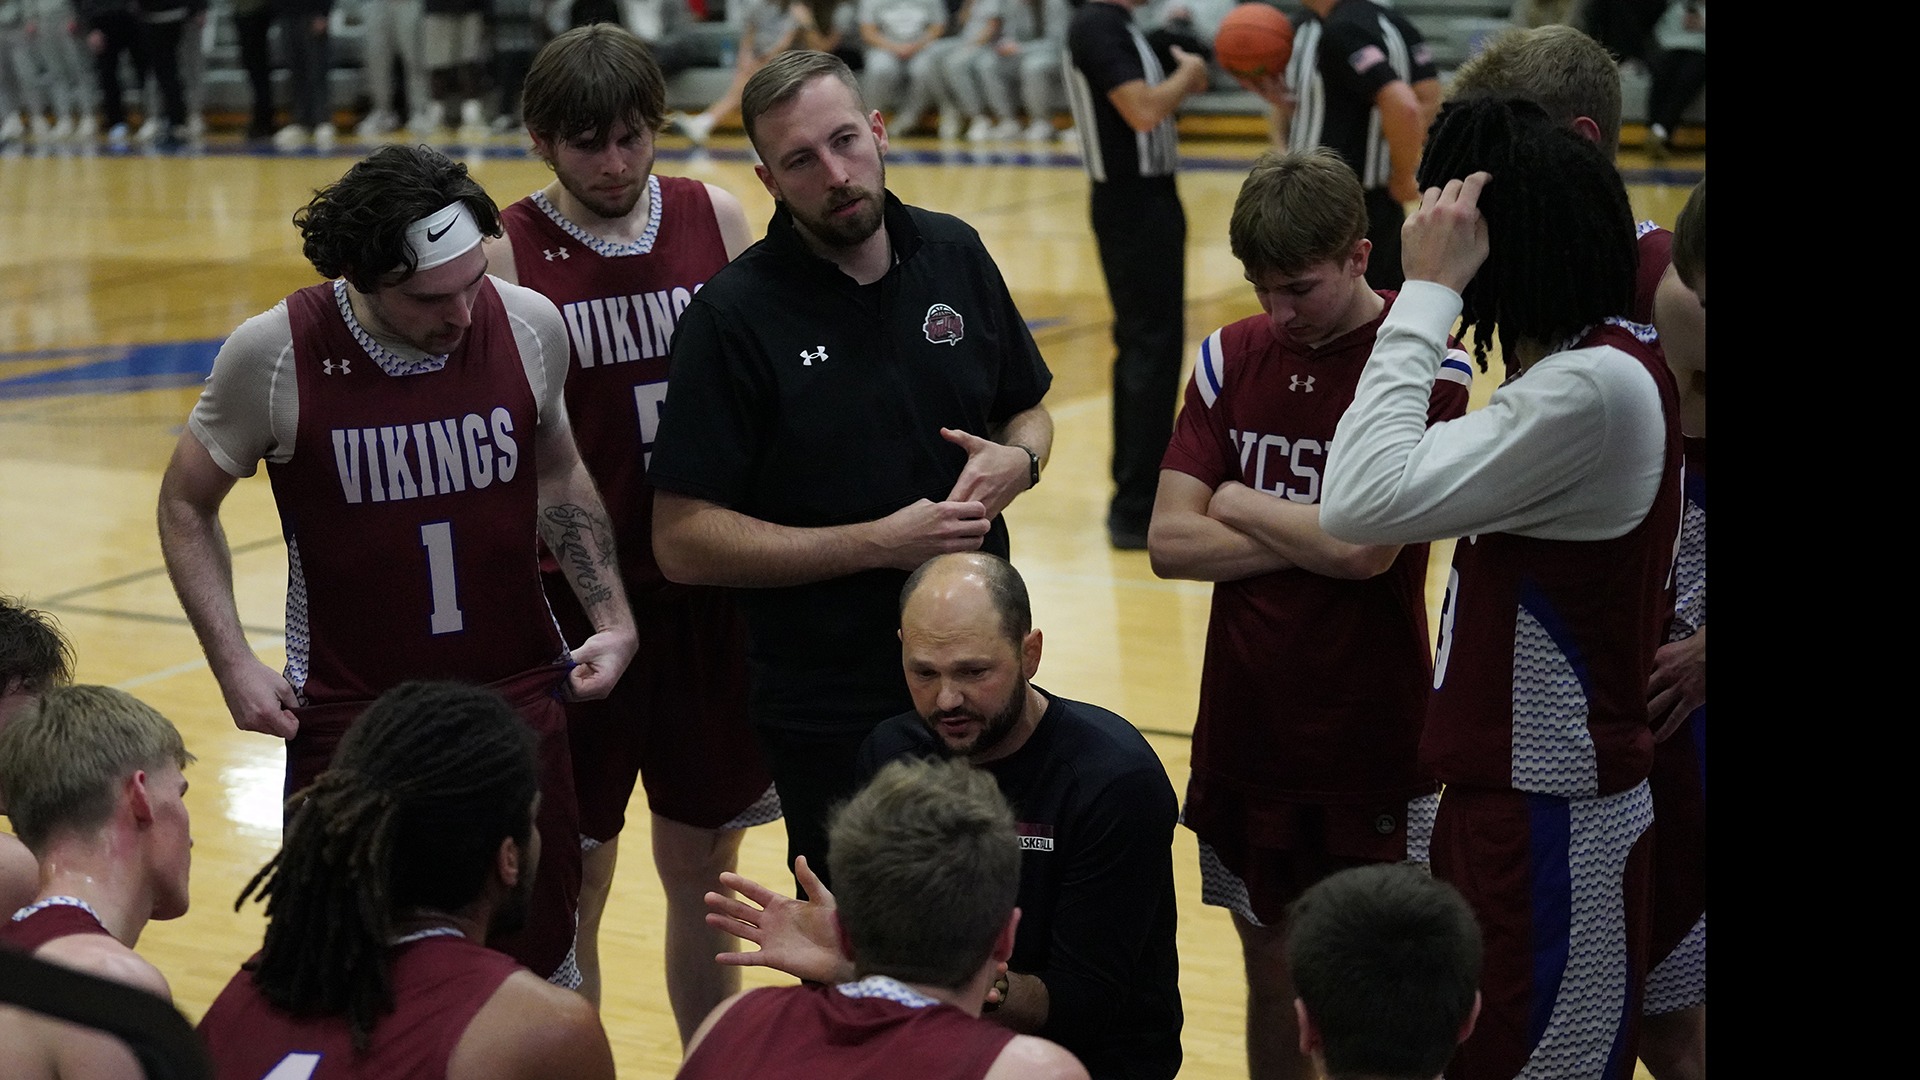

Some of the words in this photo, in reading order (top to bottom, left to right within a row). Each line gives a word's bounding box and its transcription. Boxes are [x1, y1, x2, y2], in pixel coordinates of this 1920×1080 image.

[563, 284, 704, 369] VIKIN
[331, 406, 519, 504] VIKINGS
[1229, 428, 1332, 504] VCS
[420, 521, 464, 635] 1
